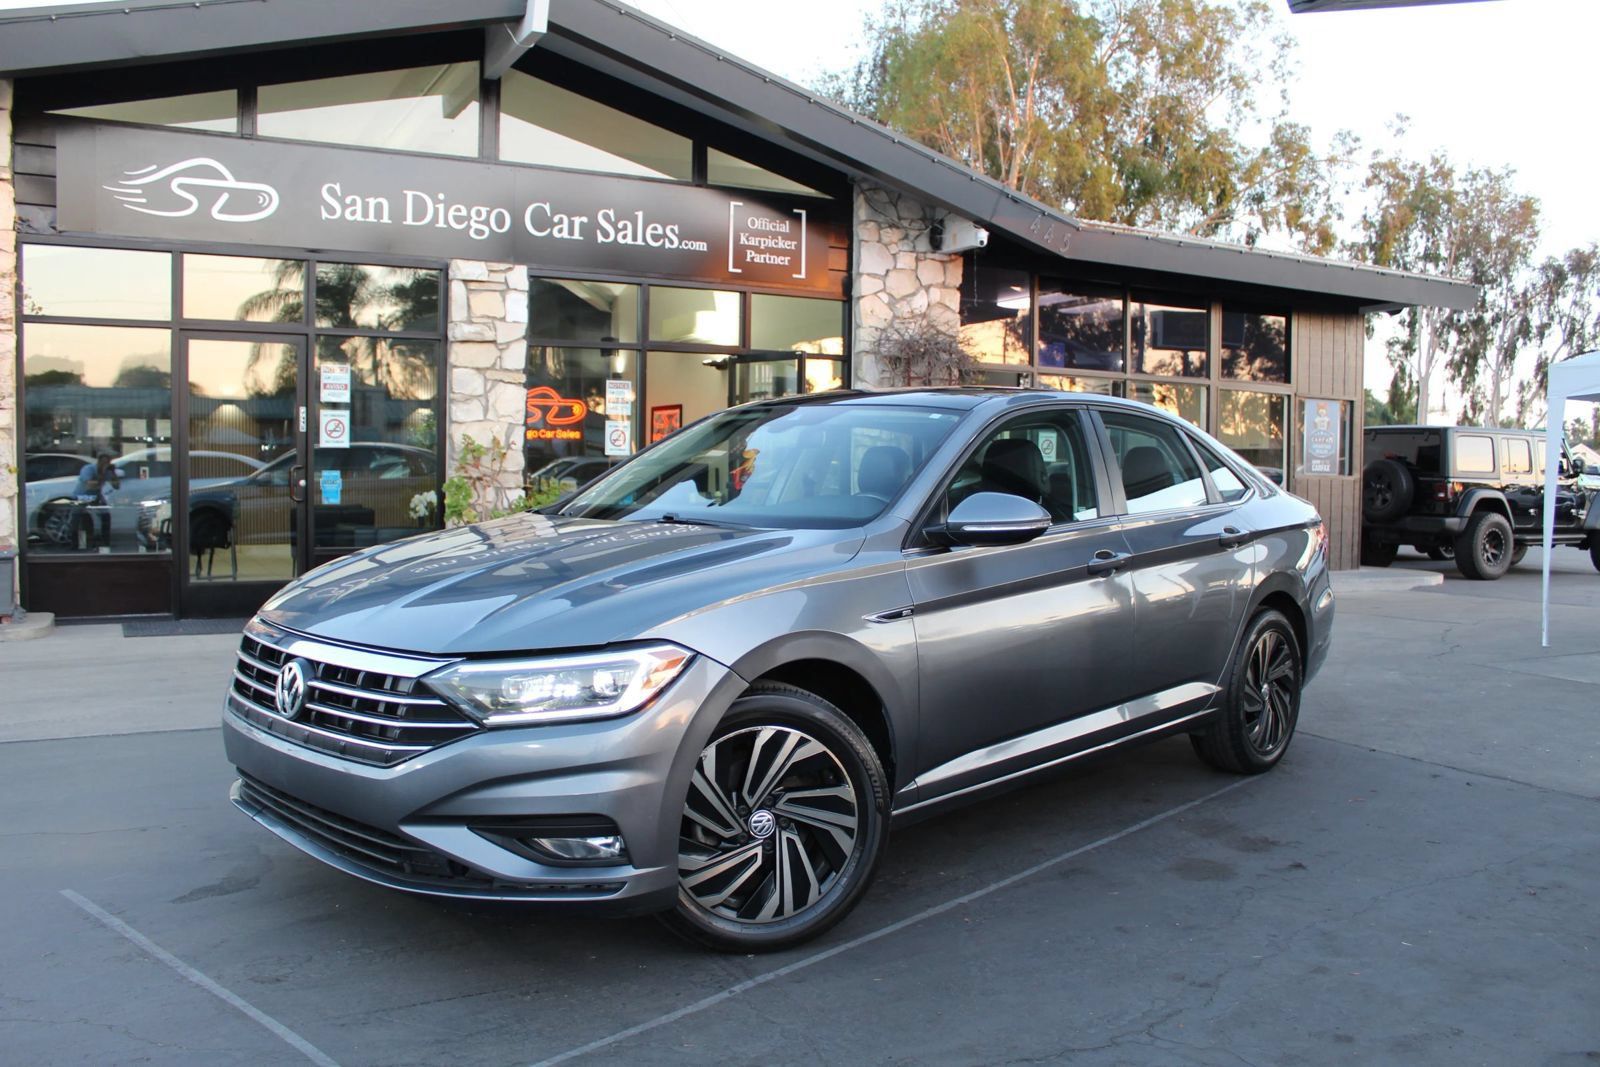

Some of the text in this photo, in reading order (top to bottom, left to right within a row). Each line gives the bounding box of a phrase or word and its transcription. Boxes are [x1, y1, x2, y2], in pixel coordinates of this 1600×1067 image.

[320, 181, 392, 224] San
[402, 189, 511, 240] Diego
[524, 202, 588, 240] Car
[747, 216, 789, 233] Official
[739, 232, 798, 250] Karpicker
[745, 249, 791, 266] Partner
[539, 429, 556, 439] Car
[556, 429, 581, 440] Sales
